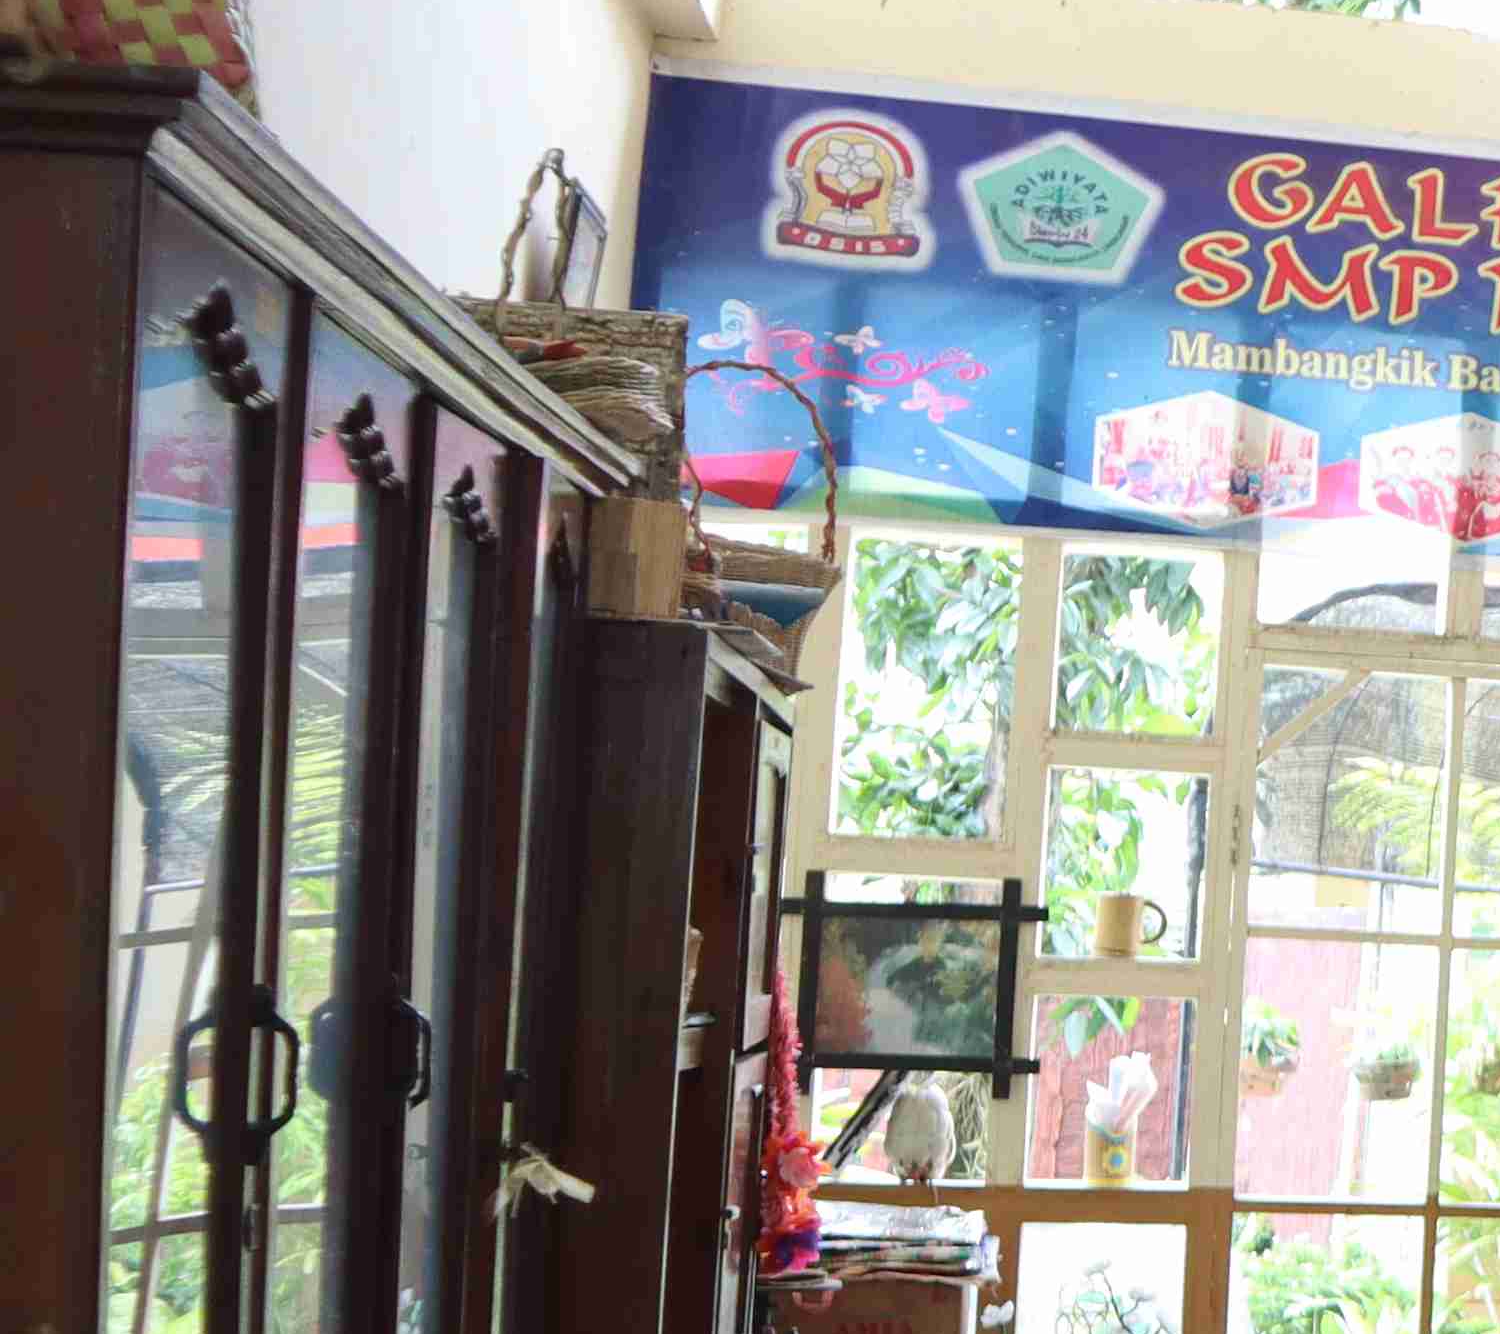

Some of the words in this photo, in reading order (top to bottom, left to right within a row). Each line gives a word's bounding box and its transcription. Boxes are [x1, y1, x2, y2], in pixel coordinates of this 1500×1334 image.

[1011, 168, 1109, 214] ADIWIYATA
[803, 230, 887, 254] OSIS
[1175, 230, 1459, 325] SMP
[1168, 328, 1439, 389] Mambangkik
